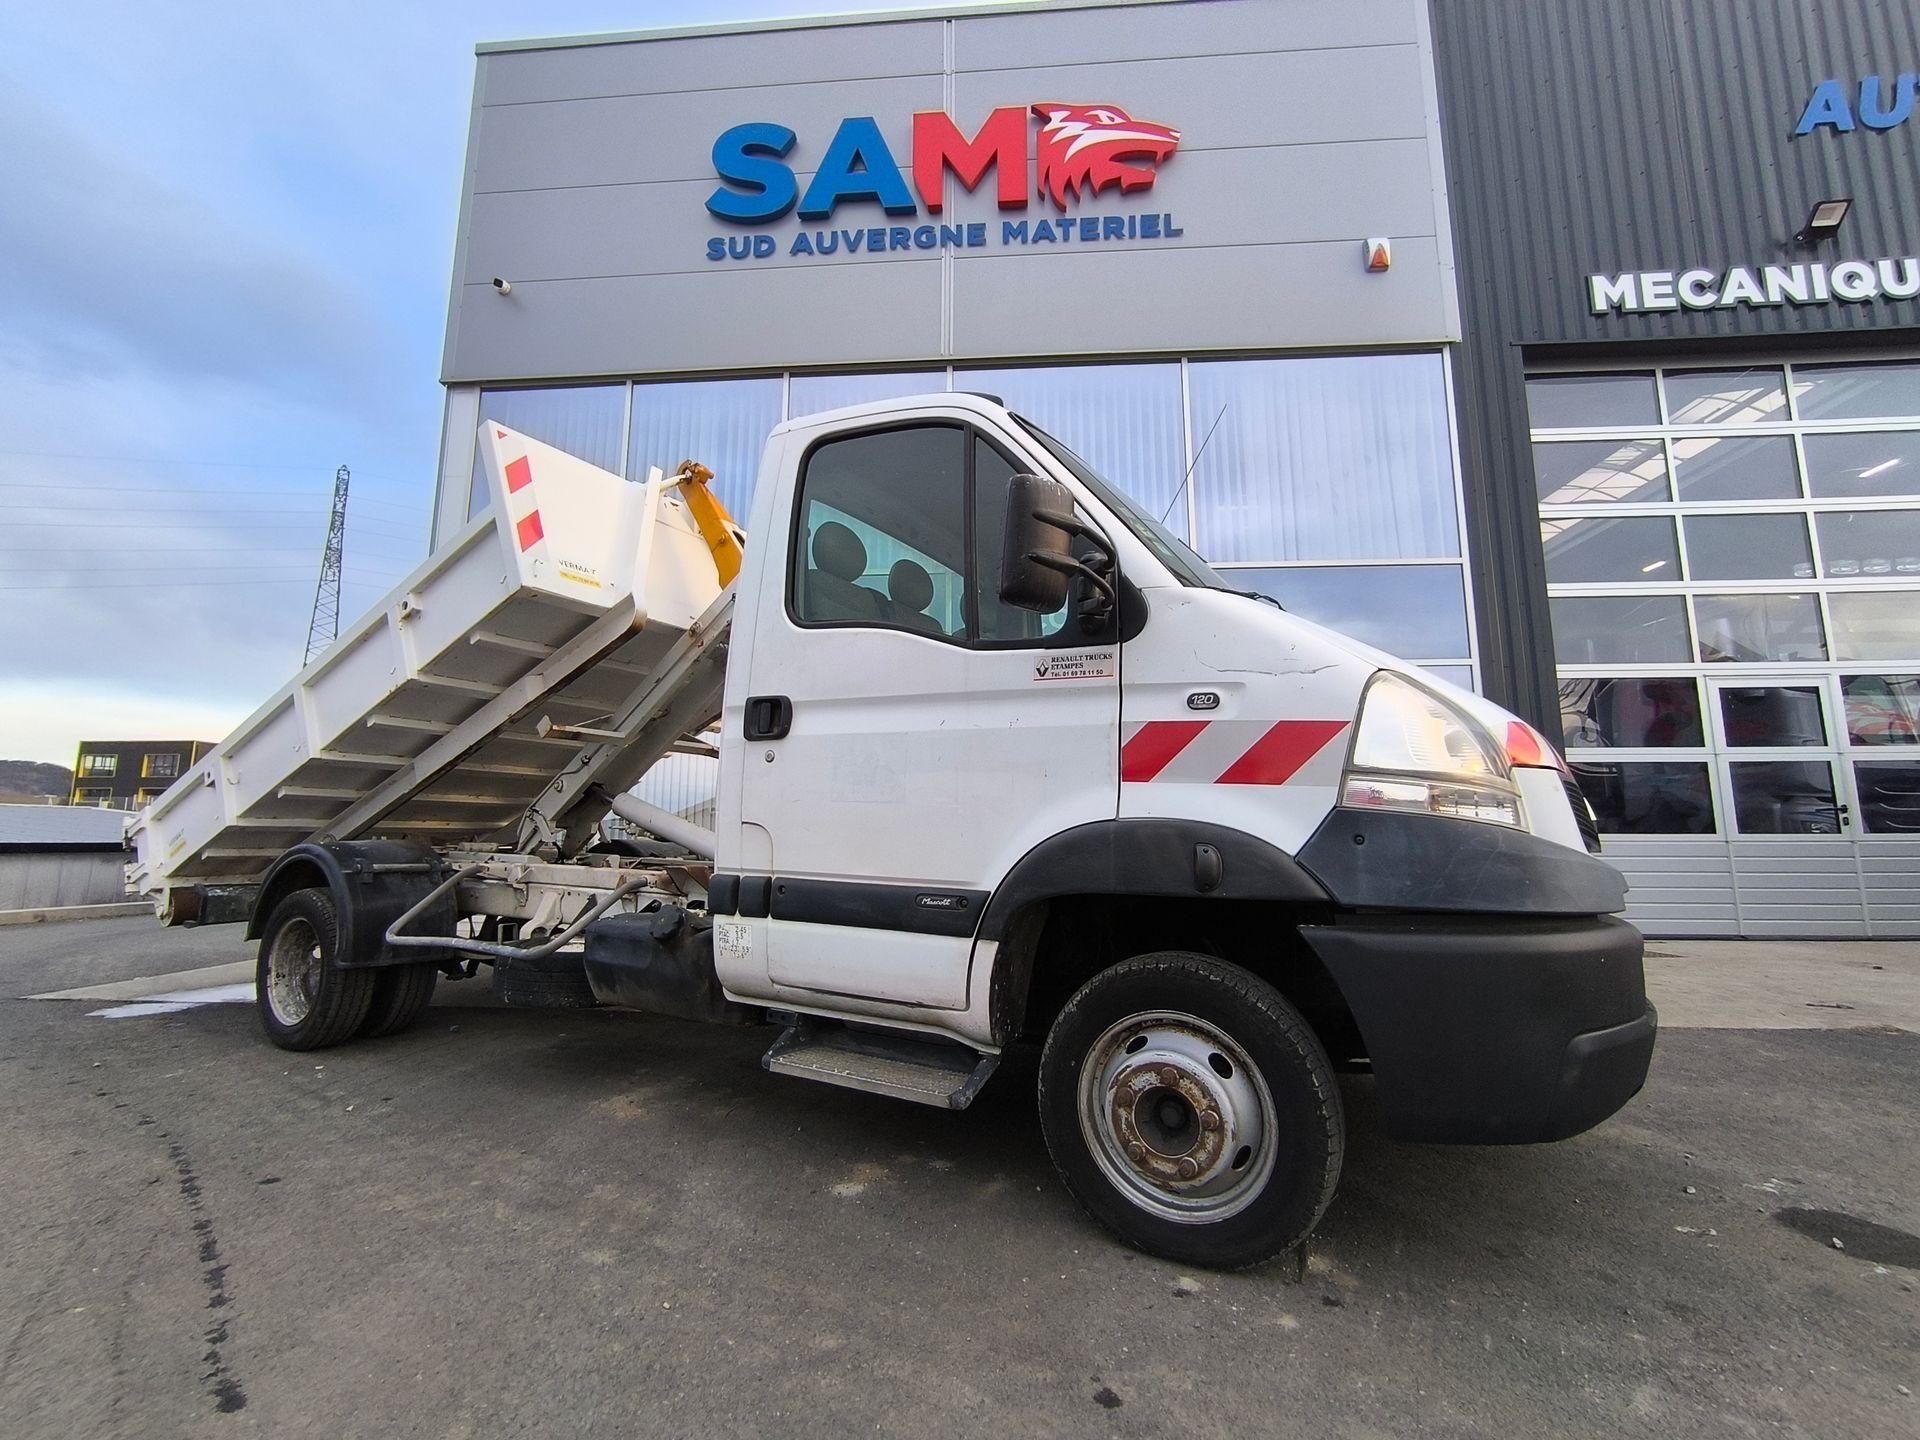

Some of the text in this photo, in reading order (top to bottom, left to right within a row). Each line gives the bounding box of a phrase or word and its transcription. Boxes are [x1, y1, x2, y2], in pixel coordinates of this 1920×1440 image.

[1795, 73, 1920, 135] AU
[704, 105, 1029, 225] SAM
[705, 212, 1185, 262] SUD AUVERGNE MATERIEL
[1589, 257, 1920, 315] MECANIQU
[1050, 653, 1113, 663] RENAULT TRUCKS
[1050, 662, 1084, 670] ETAMPES
[1191, 694, 1214, 705] 120
